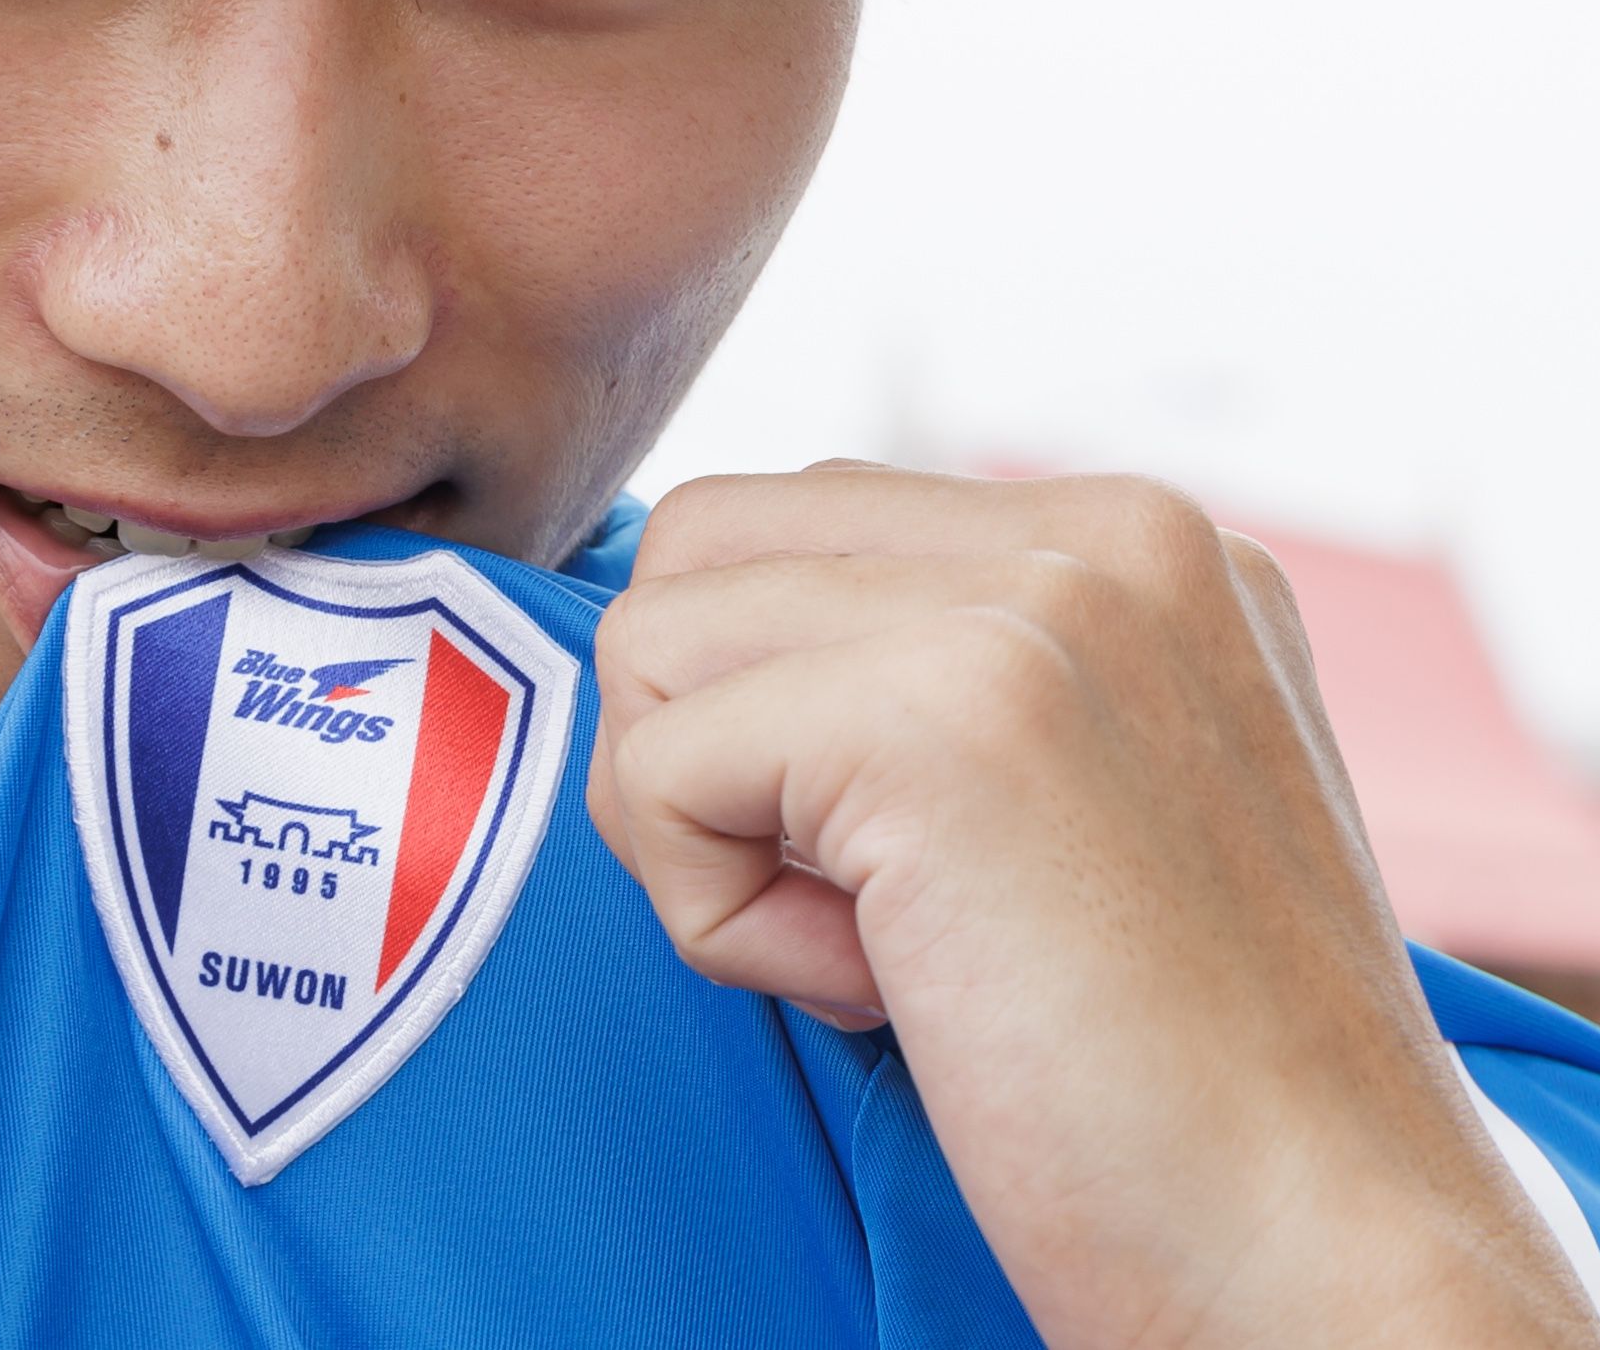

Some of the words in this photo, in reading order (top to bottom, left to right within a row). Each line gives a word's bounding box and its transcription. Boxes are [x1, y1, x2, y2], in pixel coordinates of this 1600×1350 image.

[232, 649, 307, 682] Blue
[233, 681, 394, 743] Wings
[240, 859, 338, 900] 1995
[199, 952, 346, 1010] SUWON
